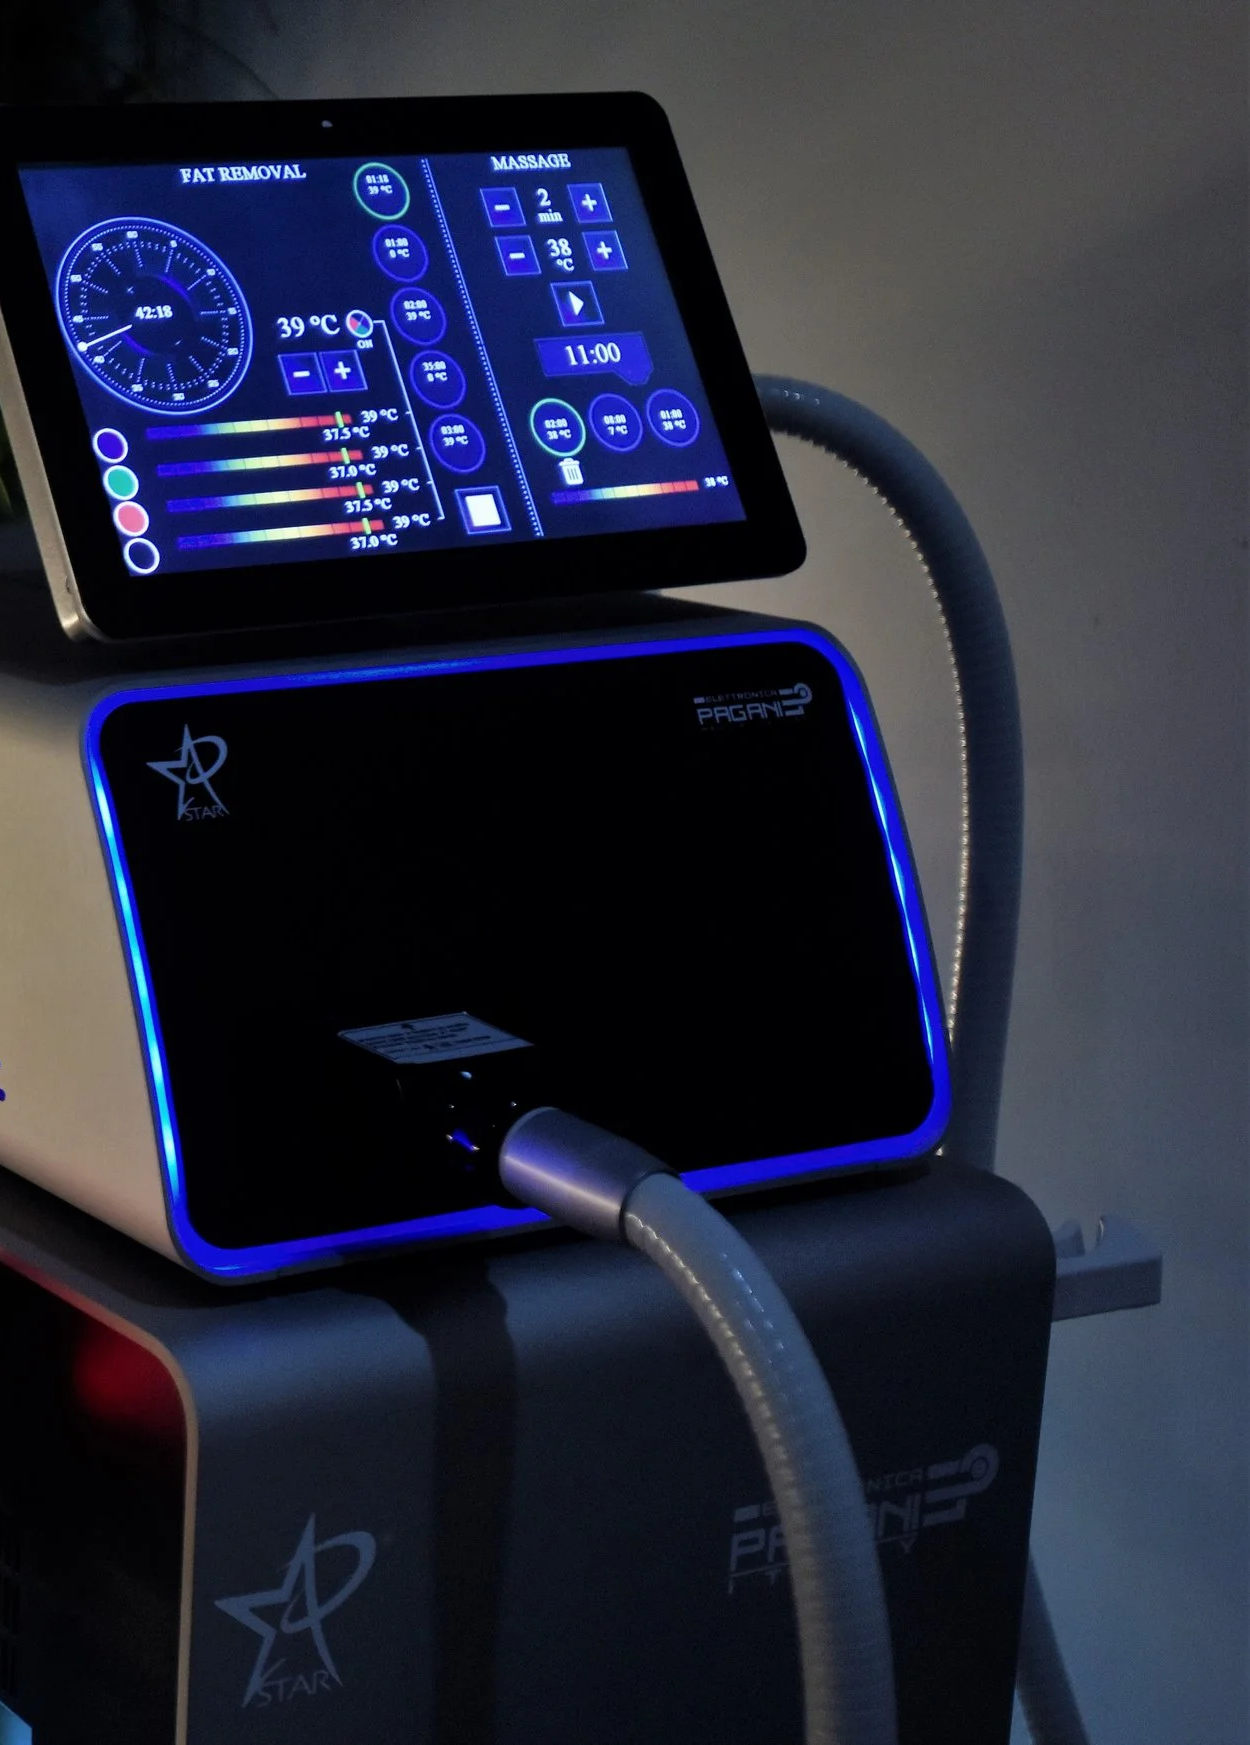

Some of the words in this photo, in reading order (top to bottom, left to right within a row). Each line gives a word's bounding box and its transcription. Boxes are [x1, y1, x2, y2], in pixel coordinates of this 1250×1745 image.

[490, 153, 572, 171] MASSAGE
[179, 167, 215, 184] FAT
[217, 164, 307, 182] REMOVAL
[536, 188, 552, 207] 2
[537, 208, 564, 223] min
[546, 237, 573, 257] 38
[135, 304, 173, 320] 42:18
[276, 316, 305, 338] 39
[565, 342, 621, 366] 11:00
[360, 409, 378, 424] 39
[321, 427, 352, 442] 37.5
[371, 445, 389, 459] 39
[328, 464, 358, 479] 37.0
[381, 479, 400, 494] 39
[343, 499, 374, 514] 37.5
[392, 515, 411, 529] 39
[350, 537, 380, 550] 37.0
[696, 701, 784, 725] PAGANI
[257, 1669, 331, 1708] STAR
